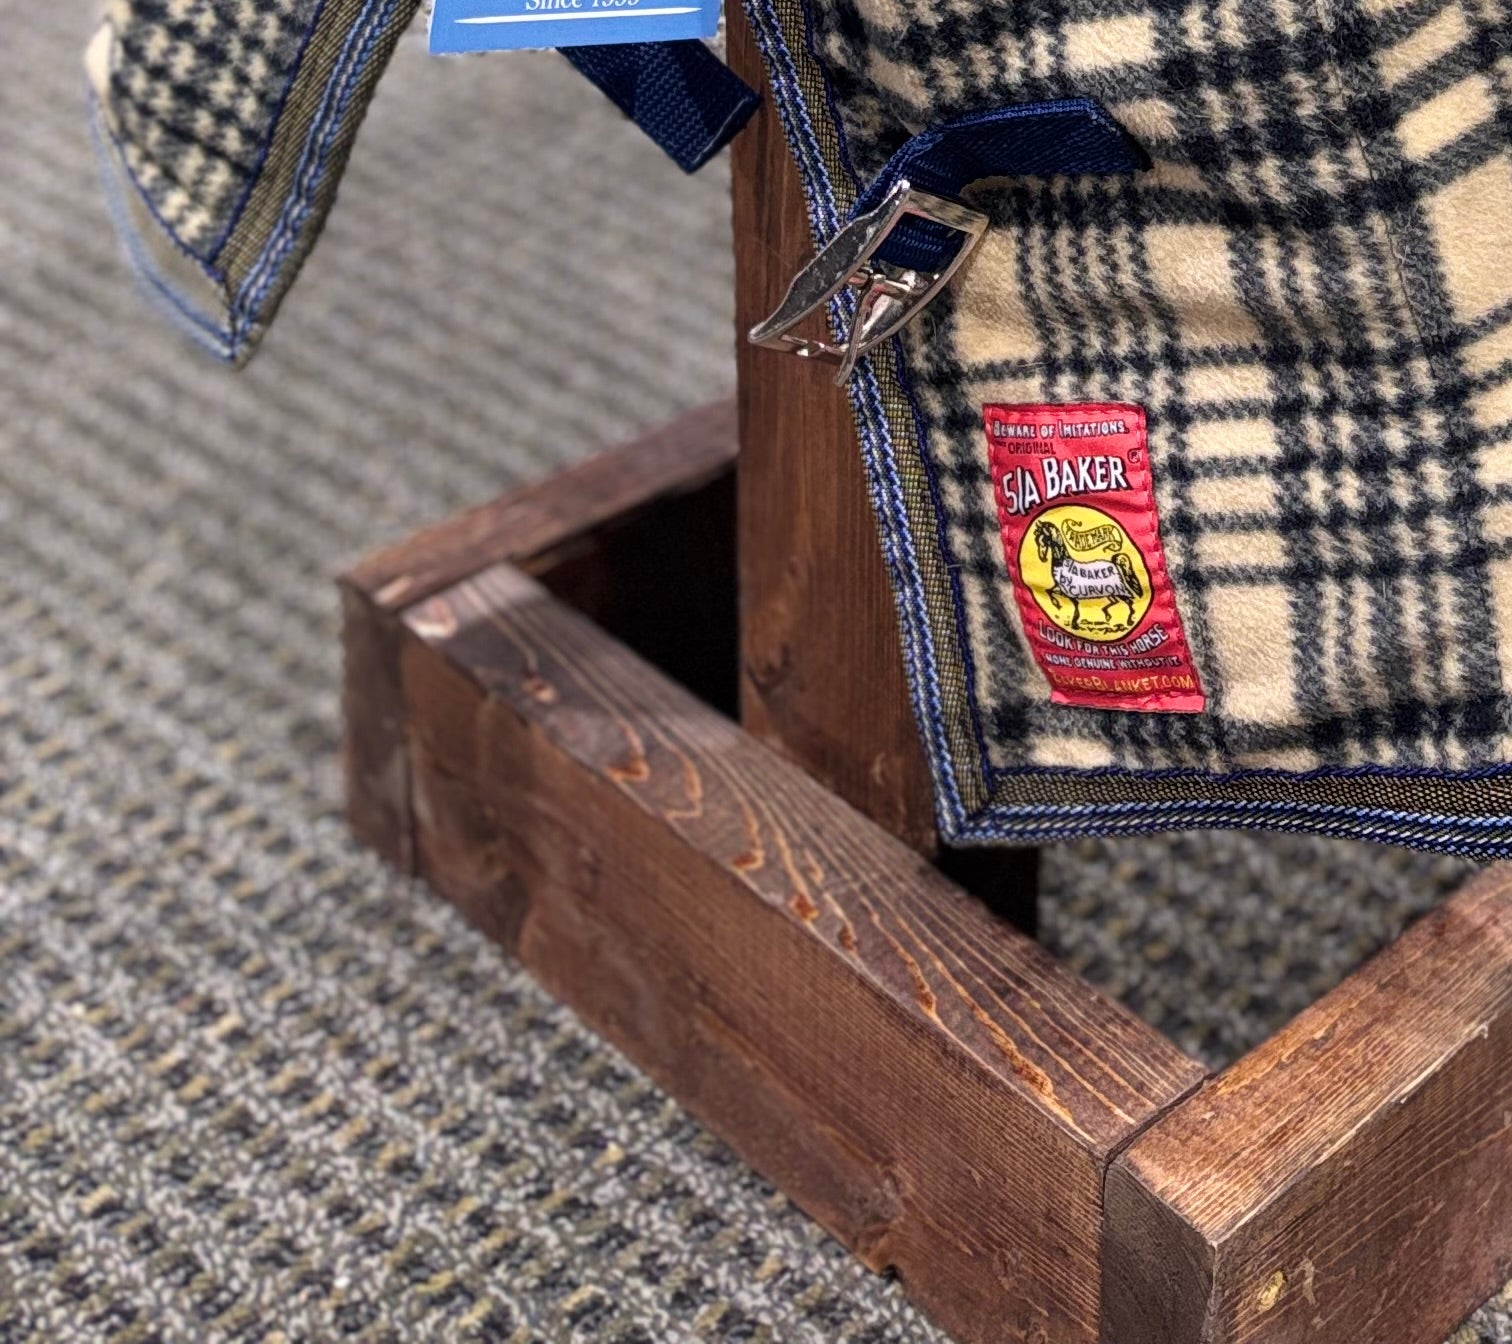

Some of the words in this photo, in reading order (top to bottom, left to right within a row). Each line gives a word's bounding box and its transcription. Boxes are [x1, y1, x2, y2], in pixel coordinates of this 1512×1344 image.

[993, 420, 1036, 437] BEWARE
[1040, 424, 1054, 438] OF
[1008, 441, 1056, 454] ORIGINAL
[1042, 456, 1129, 500] BAKER
[1060, 573, 1072, 586] by
[1080, 566, 1116, 580] BAKER
[1069, 584, 1126, 596] CURVON
[1038, 620, 1073, 650] LOOK
[1077, 642, 1099, 655] FOR
[1103, 645, 1129, 656] THIS
[1130, 623, 1169, 654] HORSE
[1074, 656, 1116, 670] GENUINE
[1119, 657, 1164, 669] WITHOUT
